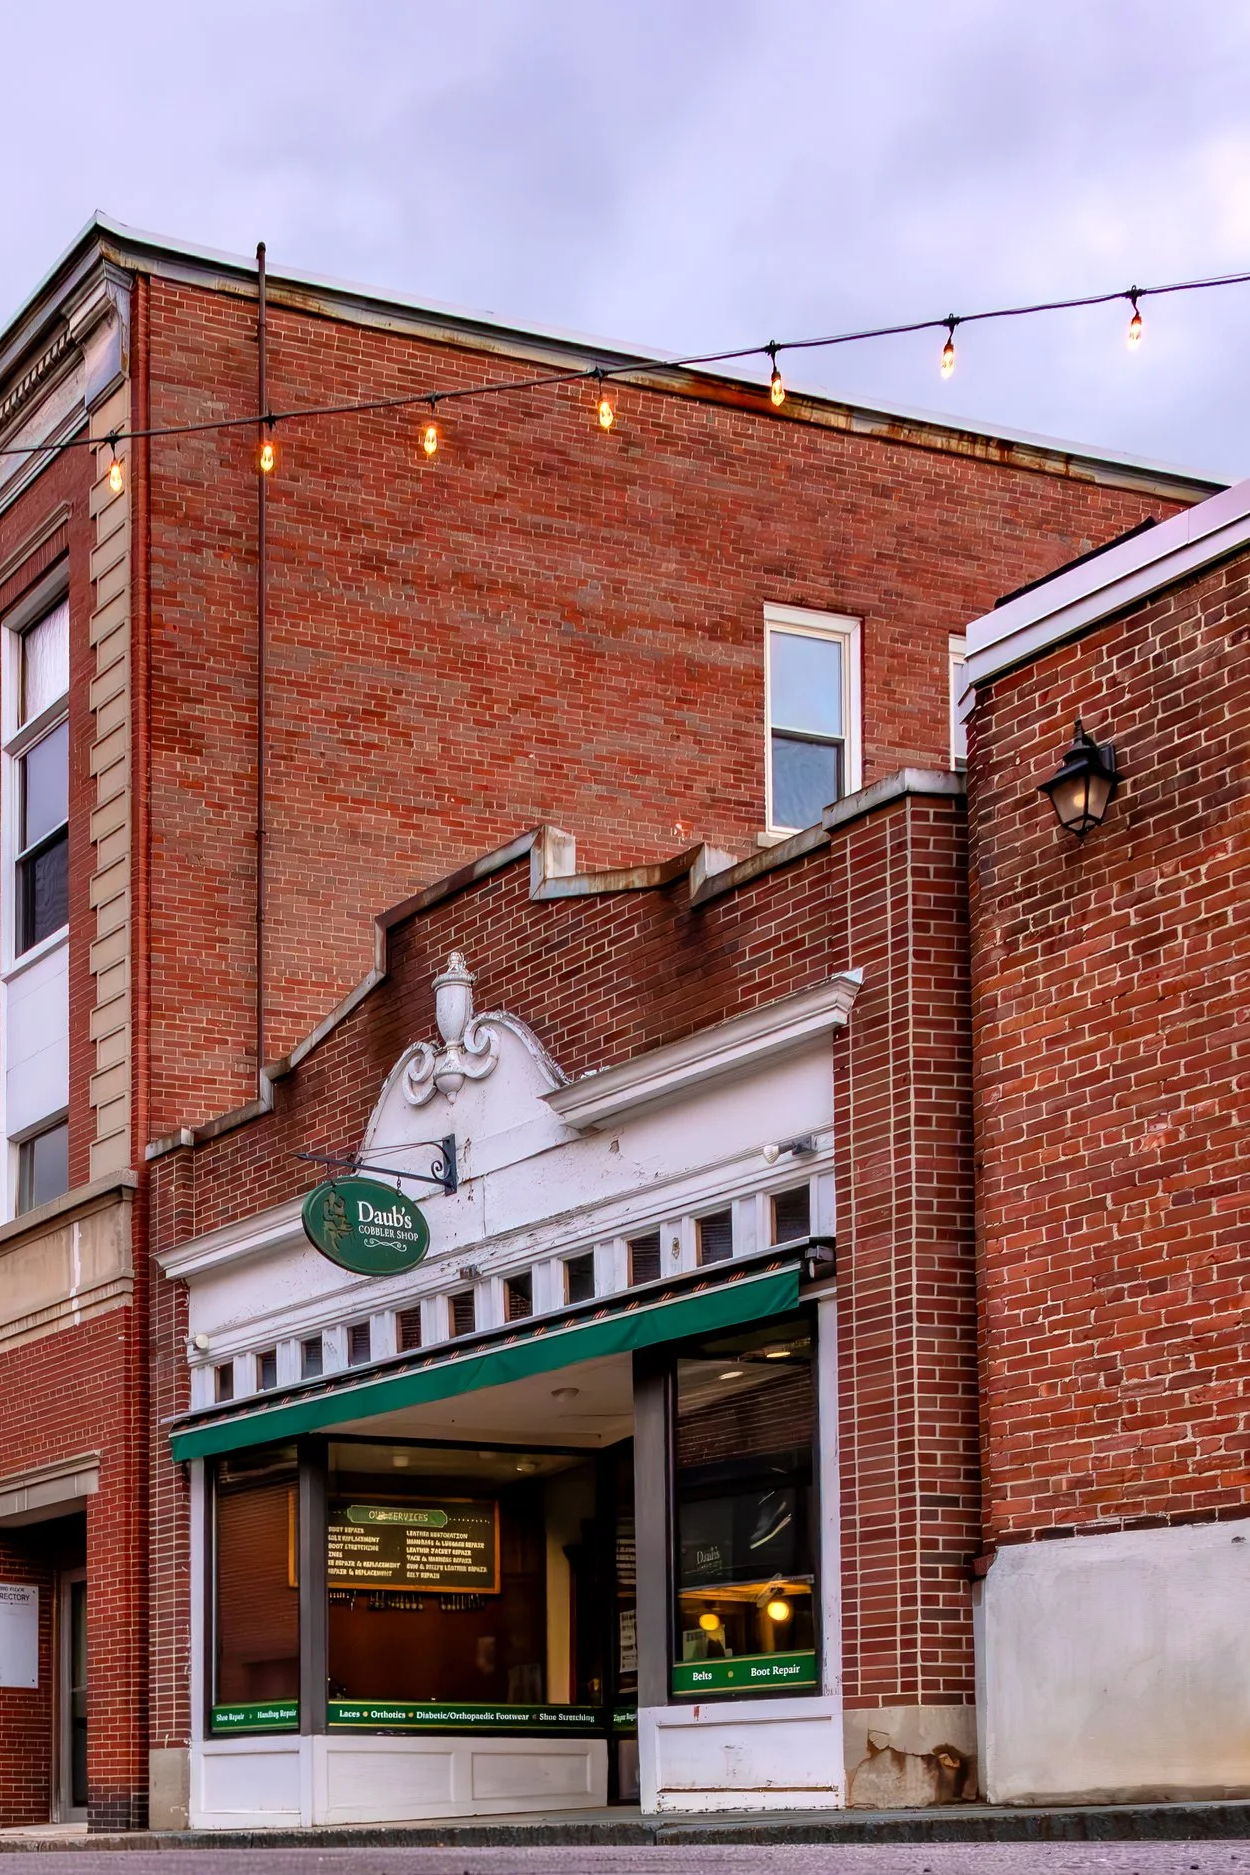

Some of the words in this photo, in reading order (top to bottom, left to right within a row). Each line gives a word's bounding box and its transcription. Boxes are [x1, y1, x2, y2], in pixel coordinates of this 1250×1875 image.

[357, 1201, 412, 1229] Daub's
[358, 1225, 395, 1238] COBBLER
[397, 1230, 419, 1241] SHOP
[692, 1671, 712, 1681] Belts
[750, 1667, 770, 1677] Boot
[772, 1664, 801, 1676] Repair
[216, 1713, 228, 1722] Shoe
[257, 1710, 279, 1719] Handbag
[339, 1709, 360, 1718] Laces
[370, 1710, 406, 1719] Orthotics
[416, 1710, 495, 1721] Diabetic/Orthopaedic
[496, 1712, 529, 1721] Footwear
[539, 1713, 557, 1721] Shoe
[558, 1713, 595, 1723] Stretching
